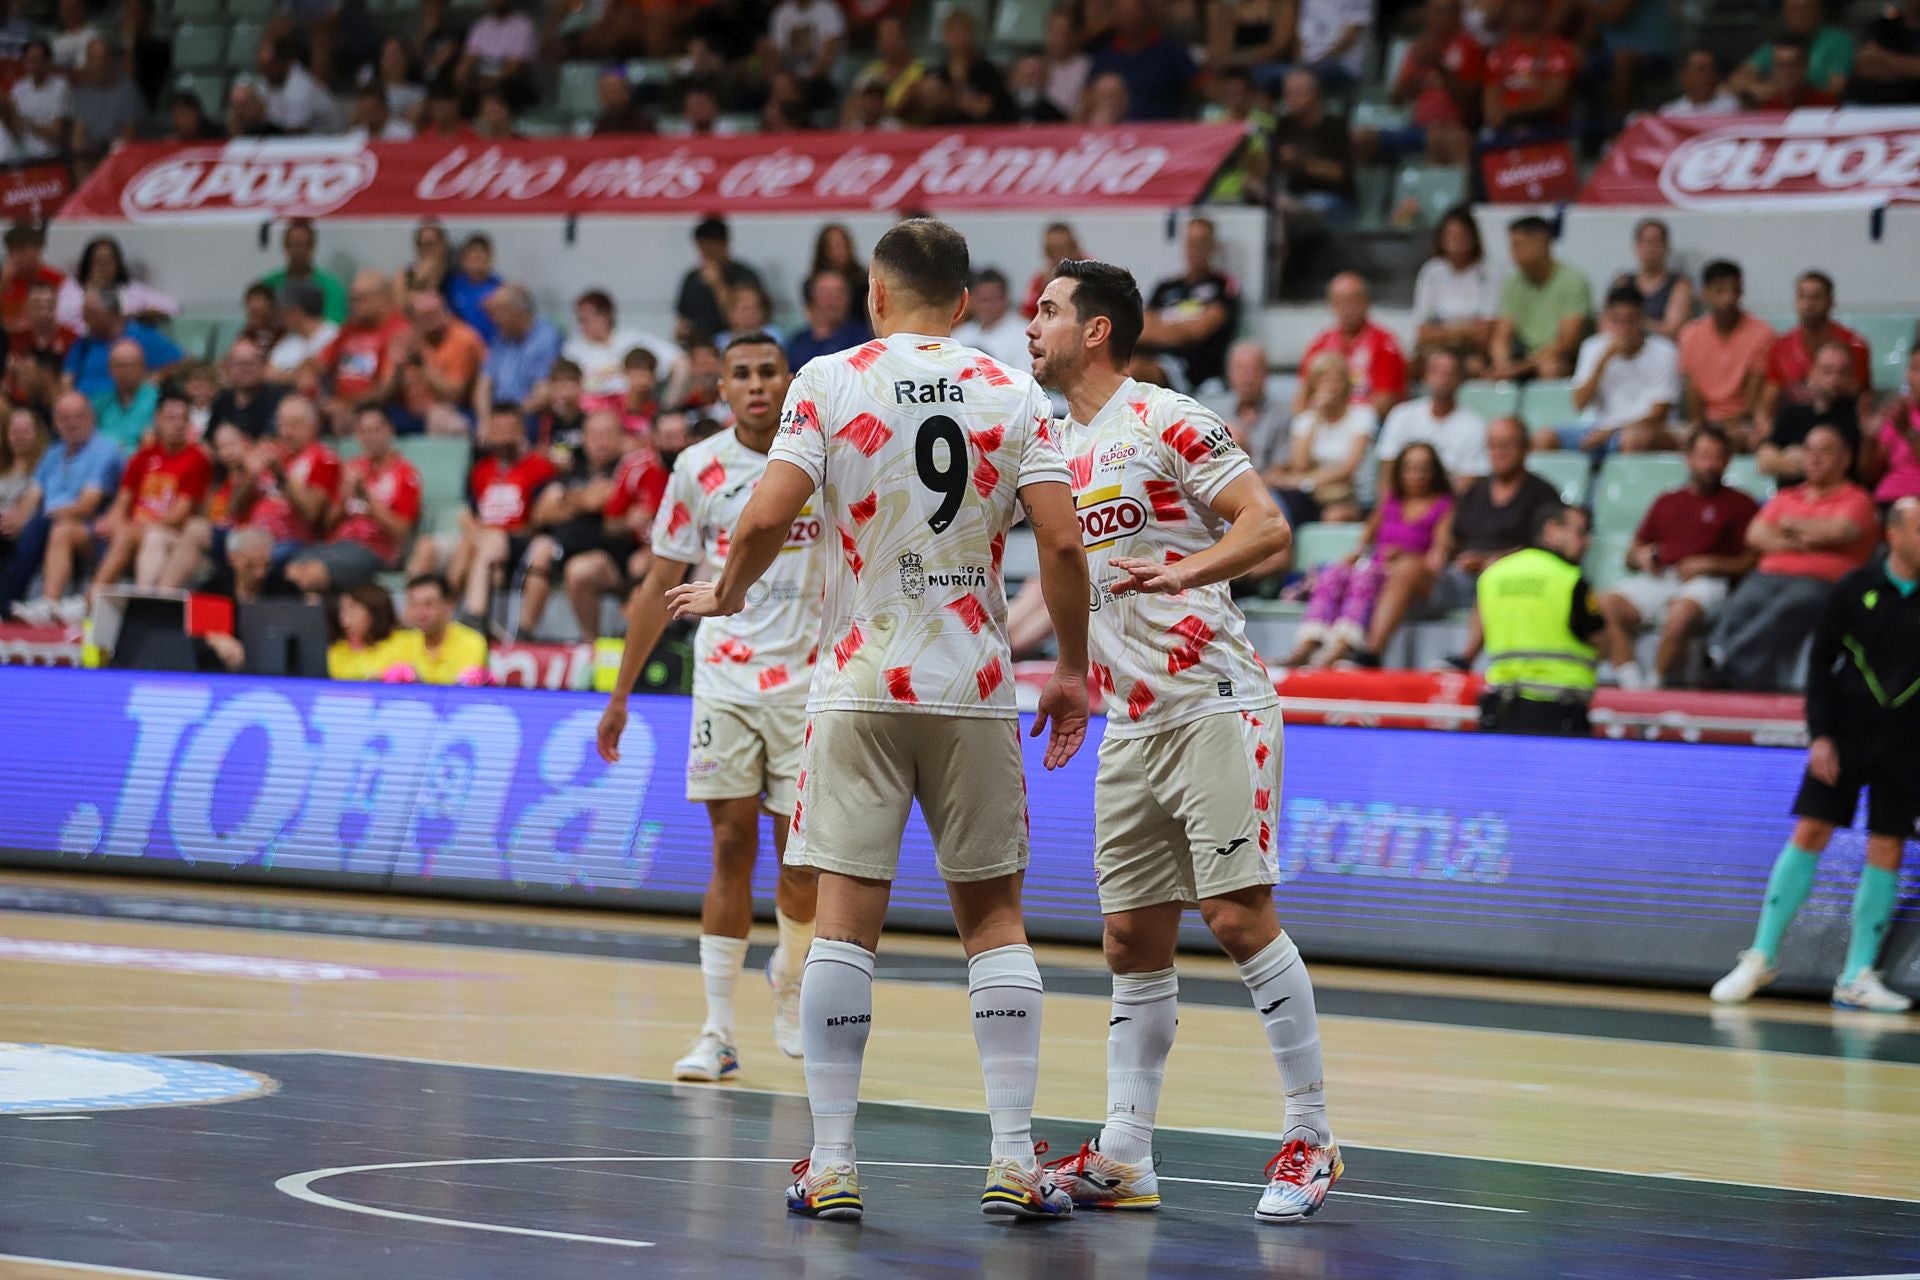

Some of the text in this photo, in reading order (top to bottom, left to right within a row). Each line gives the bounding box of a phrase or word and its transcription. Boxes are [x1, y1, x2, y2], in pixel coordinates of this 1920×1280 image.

[415, 133, 1168, 211] Uno más de la familia
[894, 378, 965, 404] Rafa
[780, 410, 809, 427] AM
[915, 415, 968, 535] 9
[928, 574, 986, 587] MURCIA
[57, 680, 664, 890] Joma
